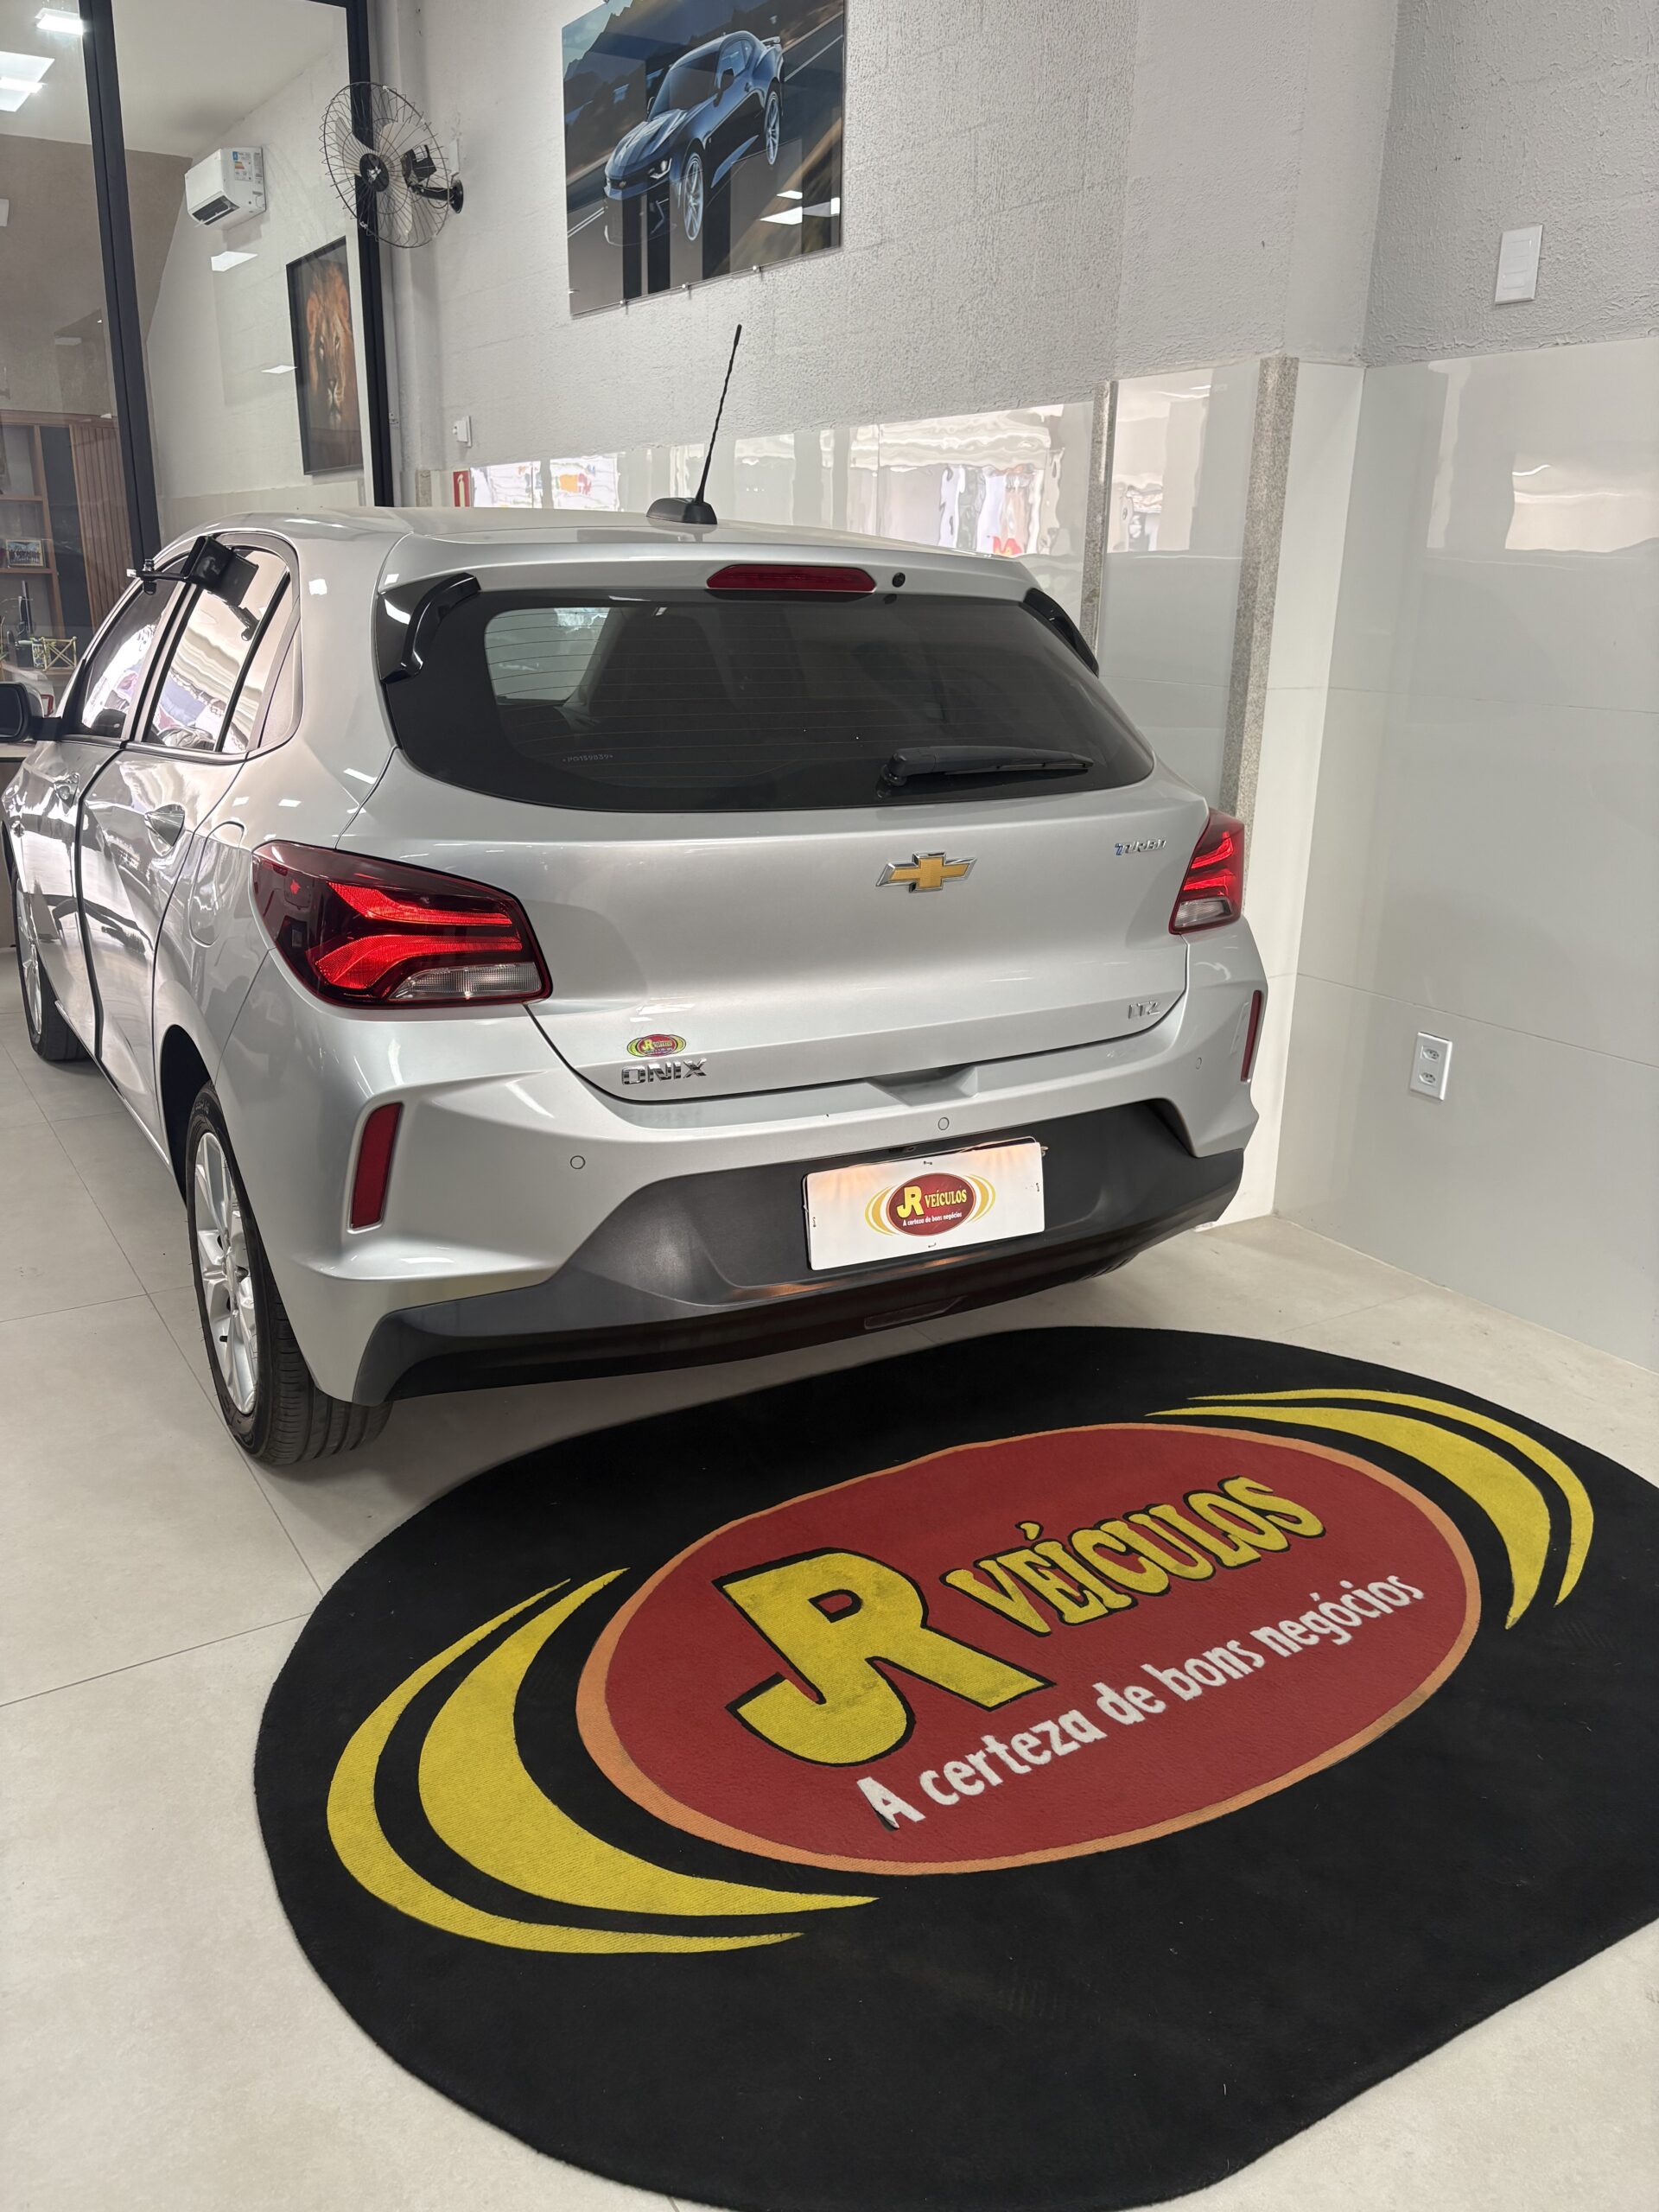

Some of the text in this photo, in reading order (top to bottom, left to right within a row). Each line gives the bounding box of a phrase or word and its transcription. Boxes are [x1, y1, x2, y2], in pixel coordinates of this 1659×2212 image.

[1128, 1001, 1160, 1019] LTZ
[621, 1058, 708, 1085] ONIX
[896, 1185, 968, 1218] JR VEÍCULOS
[715, 1476, 1326, 1766] JR VEÍCULOS
[856, 1574, 1426, 1829] A certeza de bons negócios
